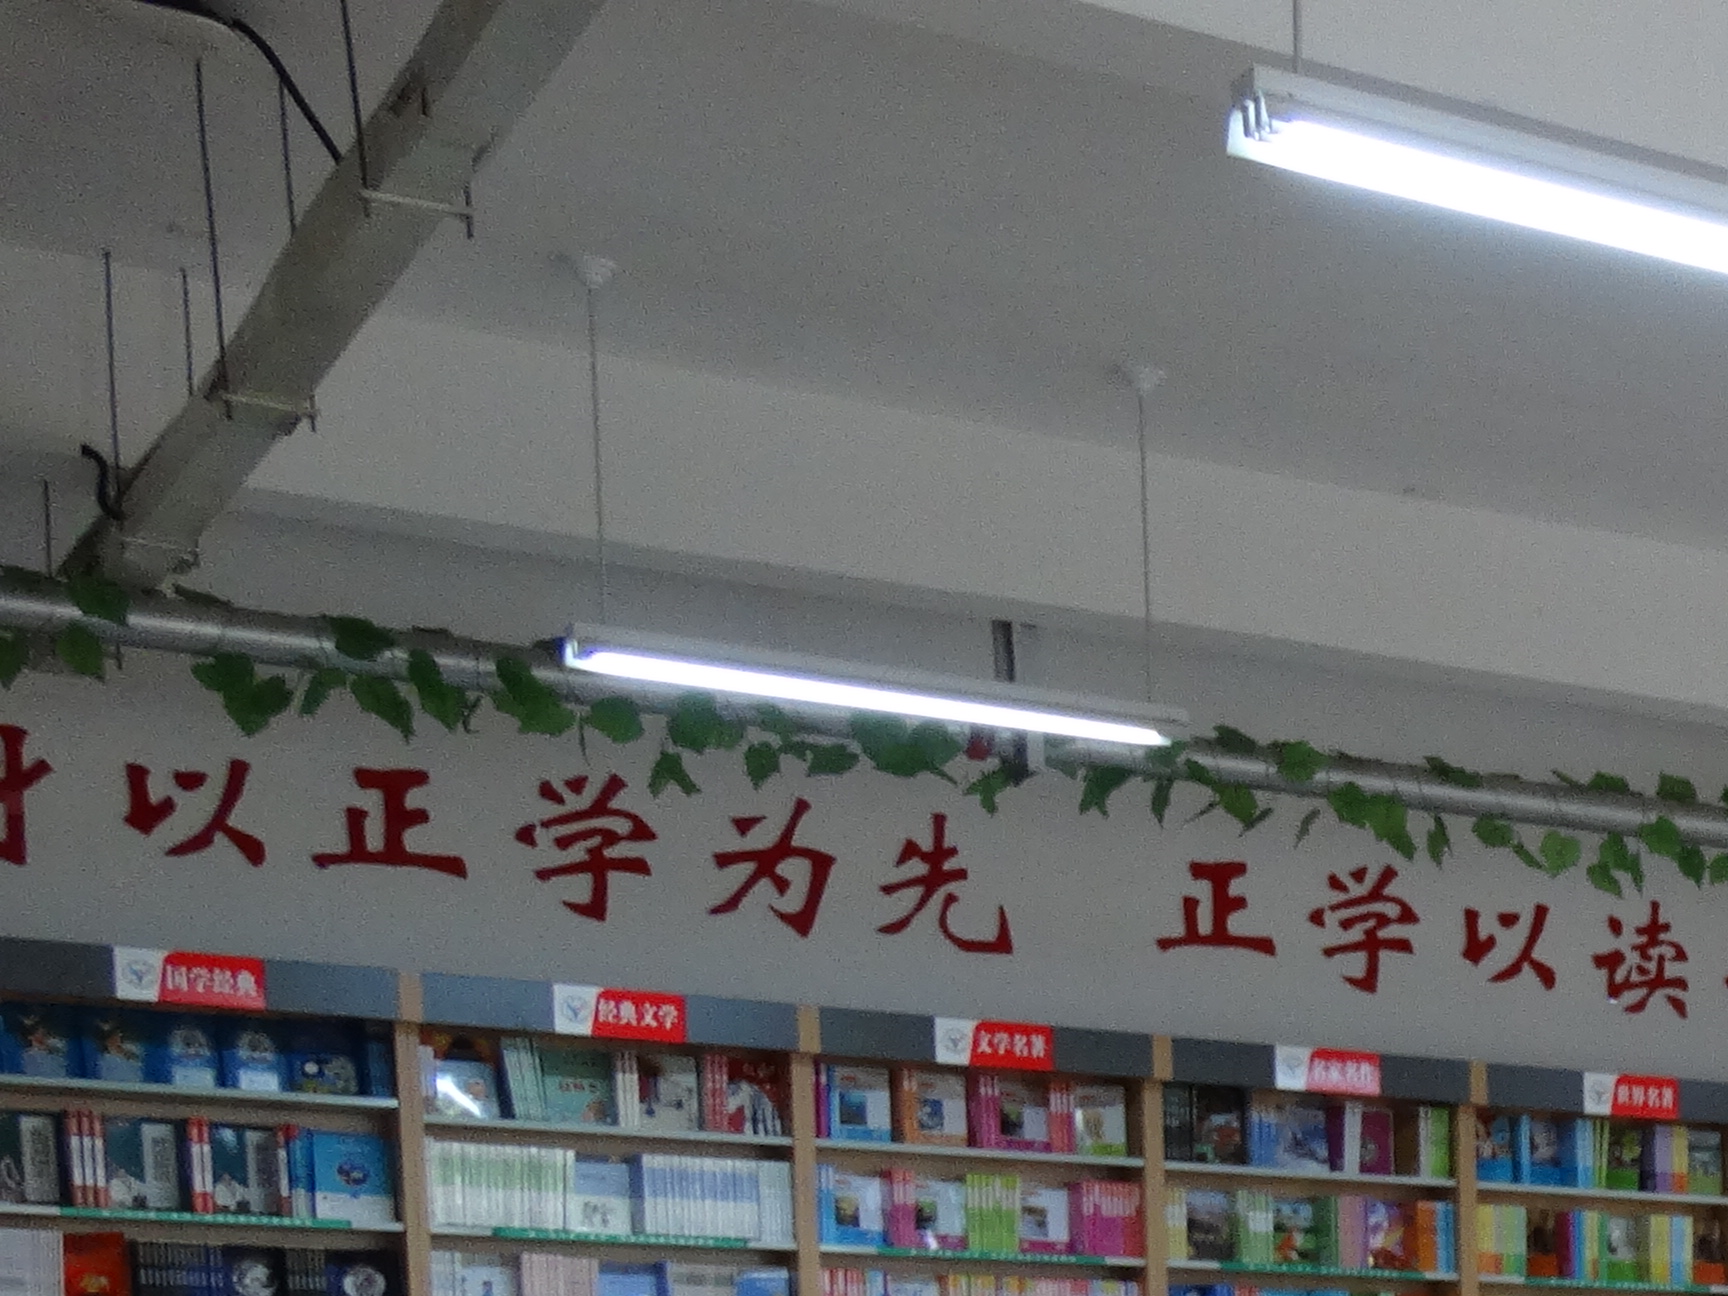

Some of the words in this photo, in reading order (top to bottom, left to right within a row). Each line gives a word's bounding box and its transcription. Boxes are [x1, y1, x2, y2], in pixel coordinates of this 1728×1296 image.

[165, 965, 257, 997] 国学经典
[598, 999, 678, 1031] 经典文学
[977, 1030, 1047, 1058] 文学名著
[1617, 1085, 1674, 1109] 世界名著
